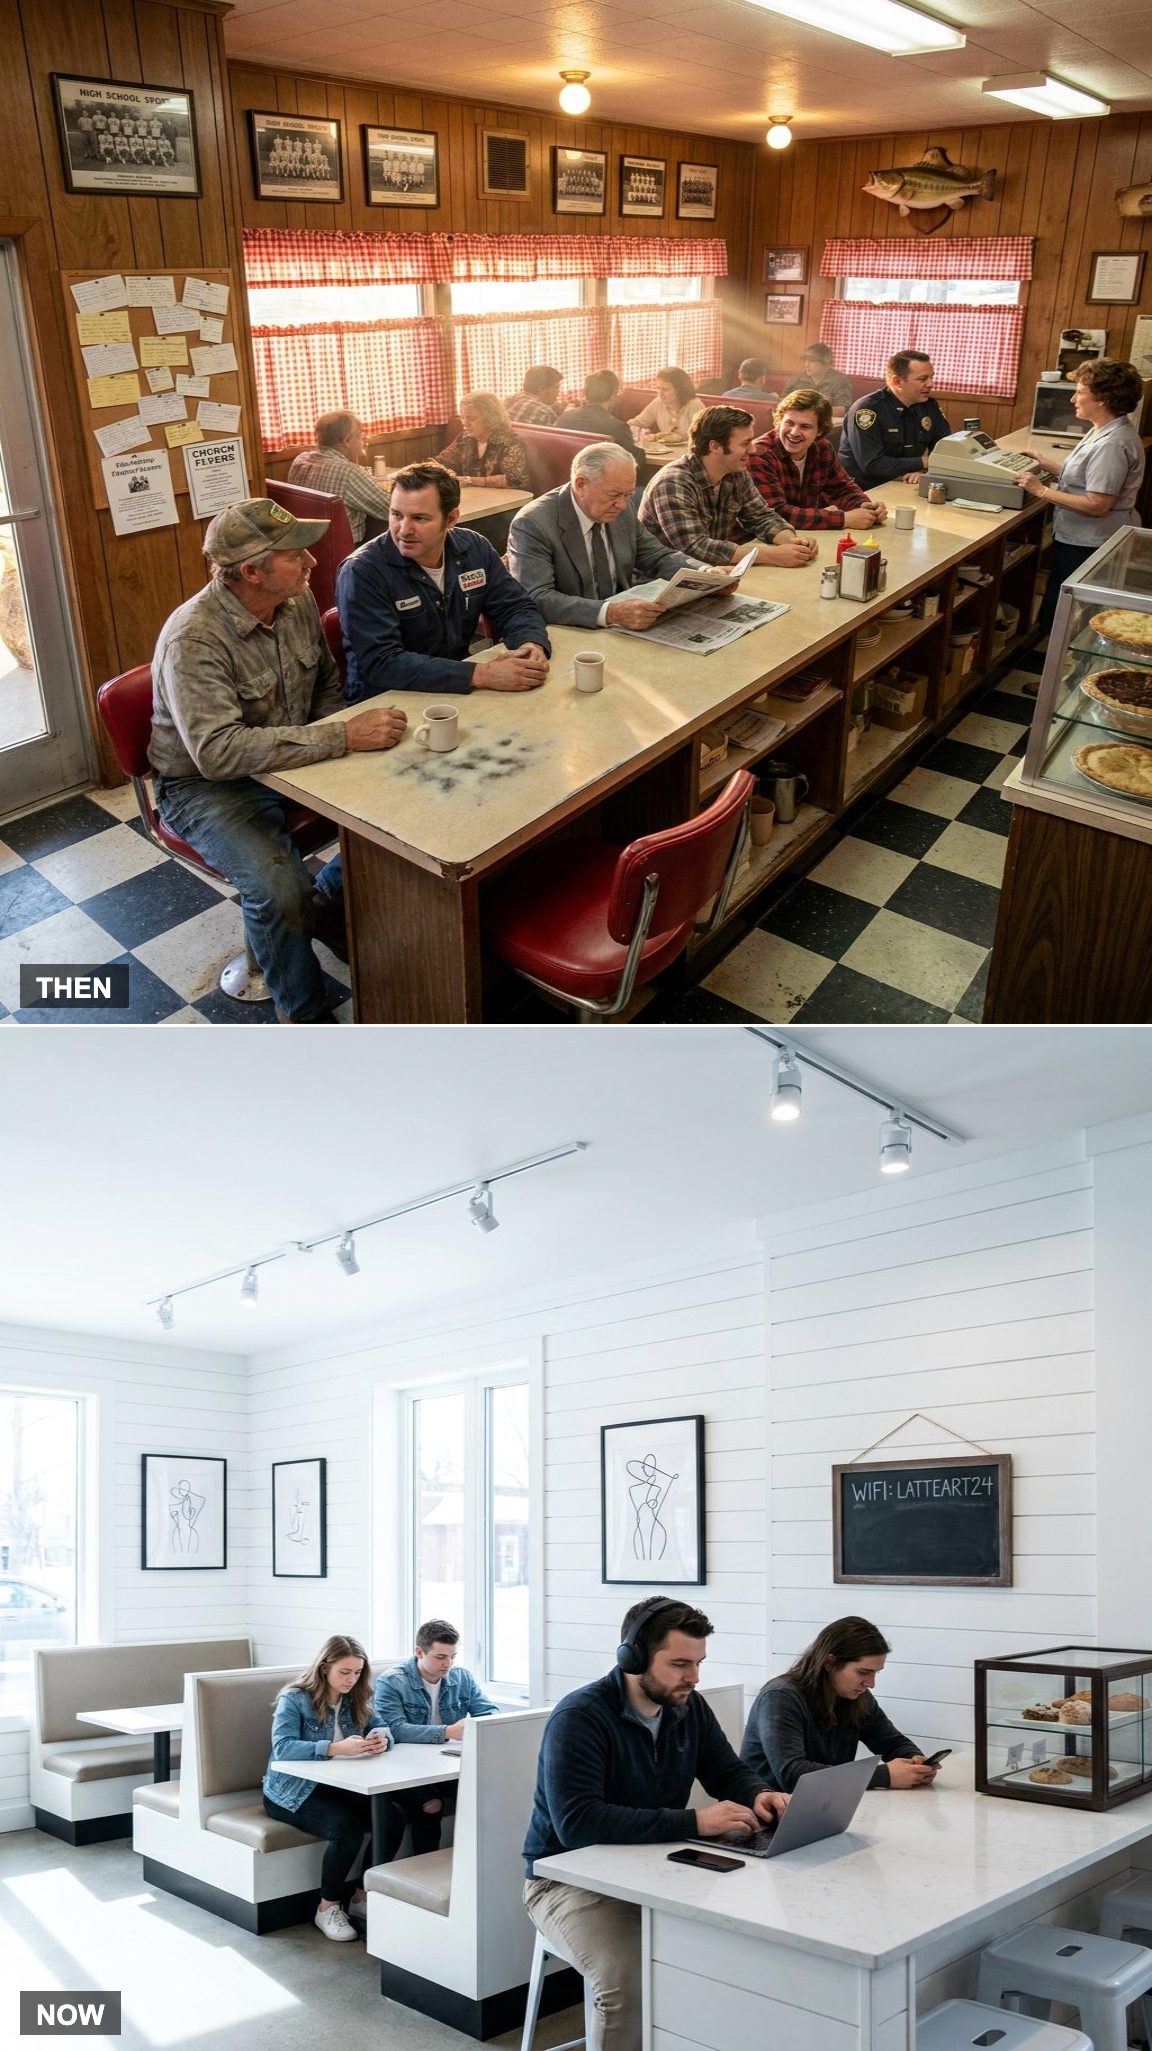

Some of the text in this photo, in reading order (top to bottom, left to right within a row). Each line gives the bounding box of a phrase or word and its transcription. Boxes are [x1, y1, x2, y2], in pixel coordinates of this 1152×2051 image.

[79, 88, 102, 99] HIGH
[106, 91, 141, 103] SCHOOL
[851, 1475, 994, 1502] WIFI: LATTEART24
